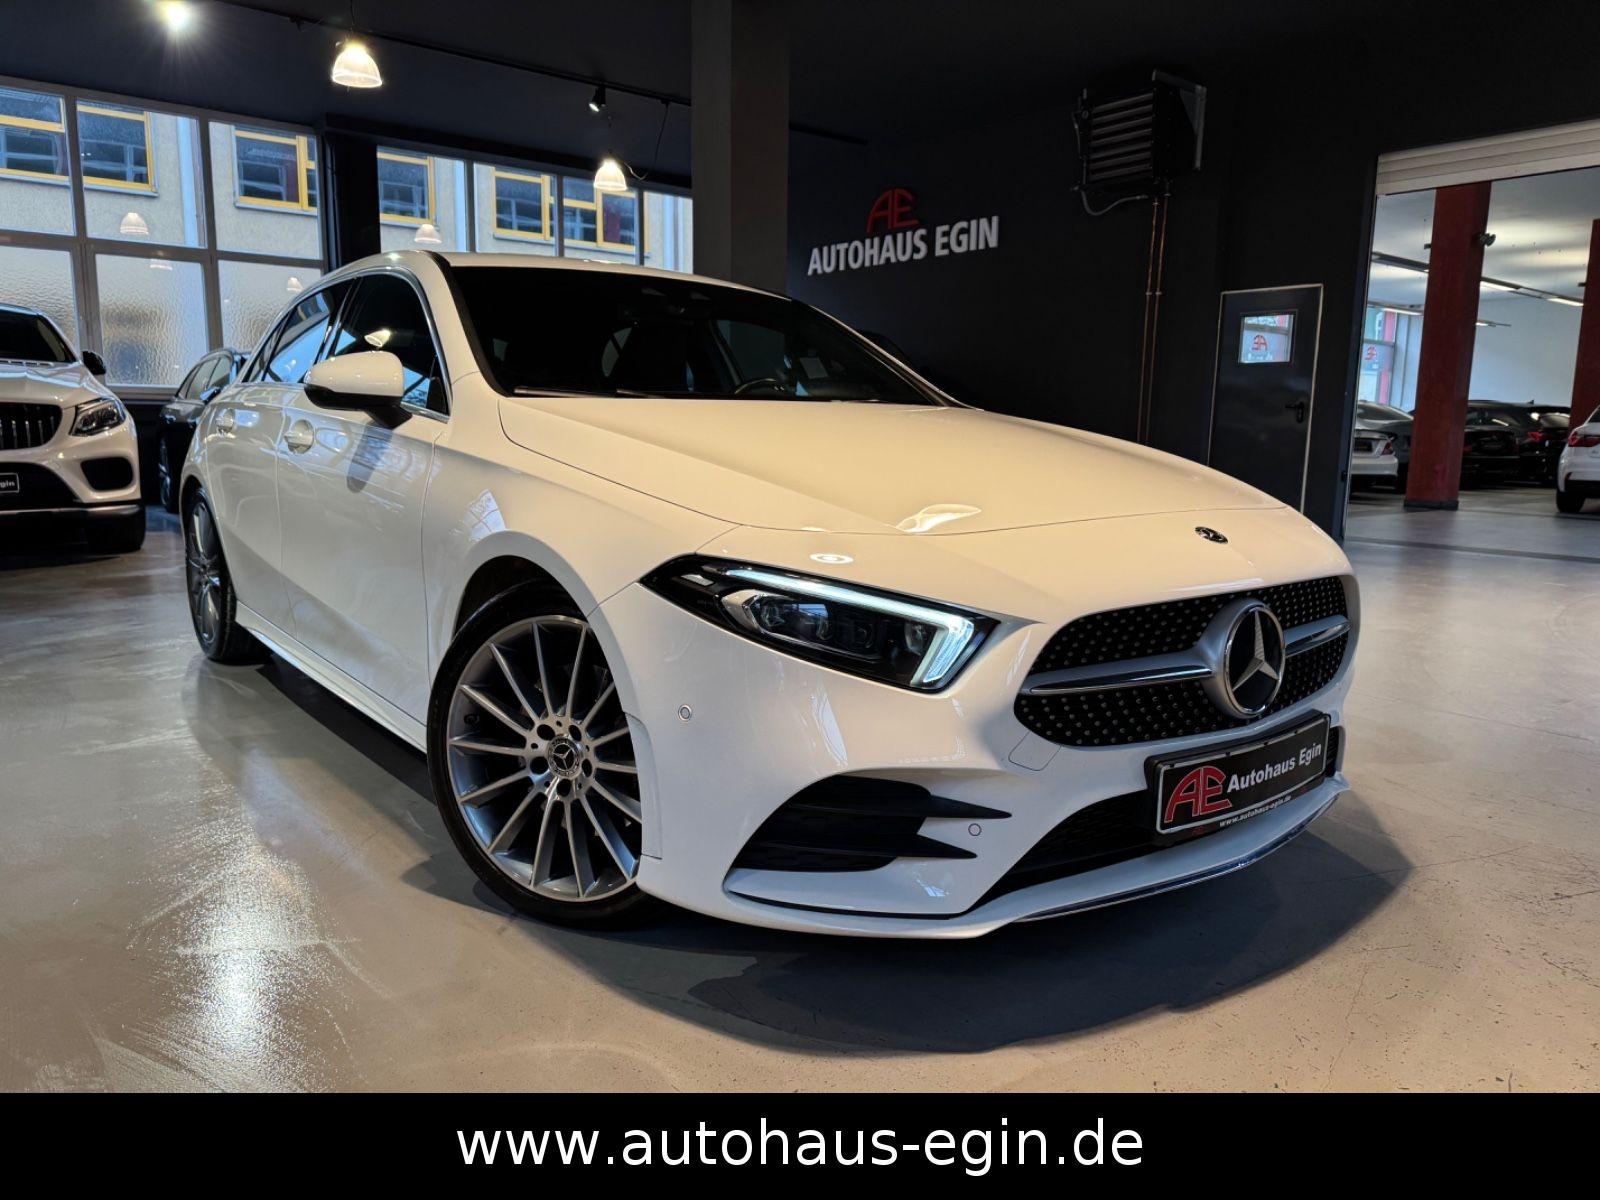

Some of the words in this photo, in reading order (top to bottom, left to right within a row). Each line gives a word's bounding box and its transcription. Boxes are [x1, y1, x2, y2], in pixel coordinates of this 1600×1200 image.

[866, 187, 920, 234] AE
[807, 228, 928, 276] AUTOHAUS
[935, 215, 999, 257] EGIN
[1164, 765, 1233, 824] AE
[1226, 755, 1295, 794] Autohaus
[1298, 743, 1322, 767] Egin
